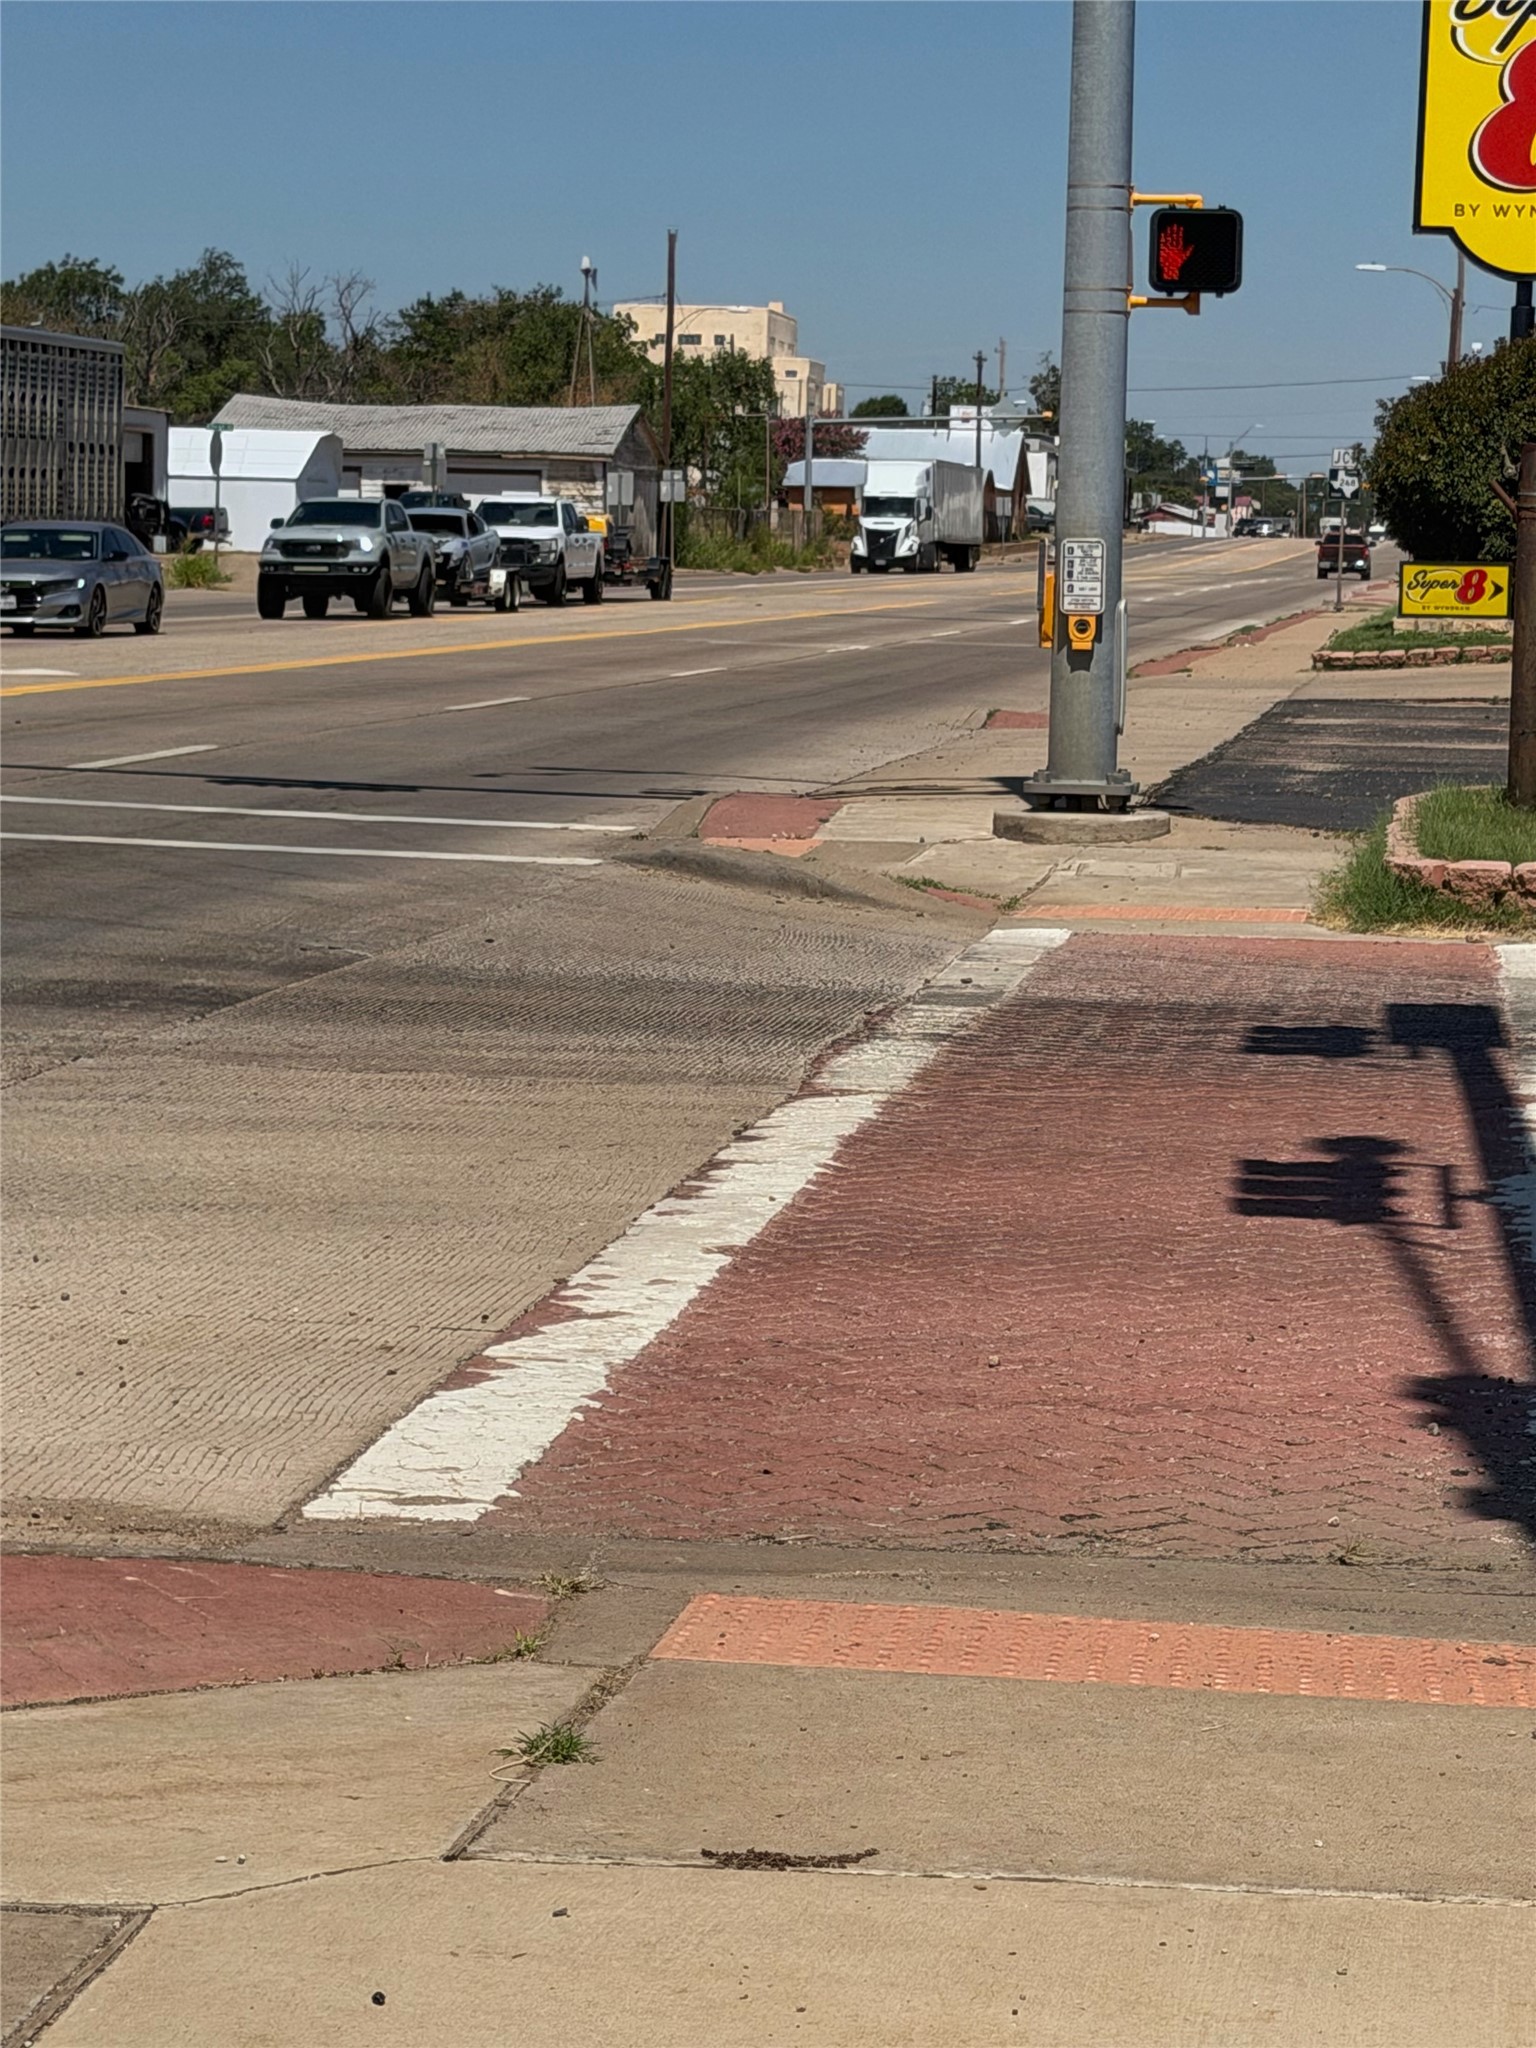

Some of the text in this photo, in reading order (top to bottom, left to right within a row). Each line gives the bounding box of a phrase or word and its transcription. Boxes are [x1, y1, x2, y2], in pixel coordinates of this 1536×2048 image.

[1454, 203, 1481, 217] BY
[1334, 451, 1356, 464] JC
[1407, 568, 1488, 605] Super 8
